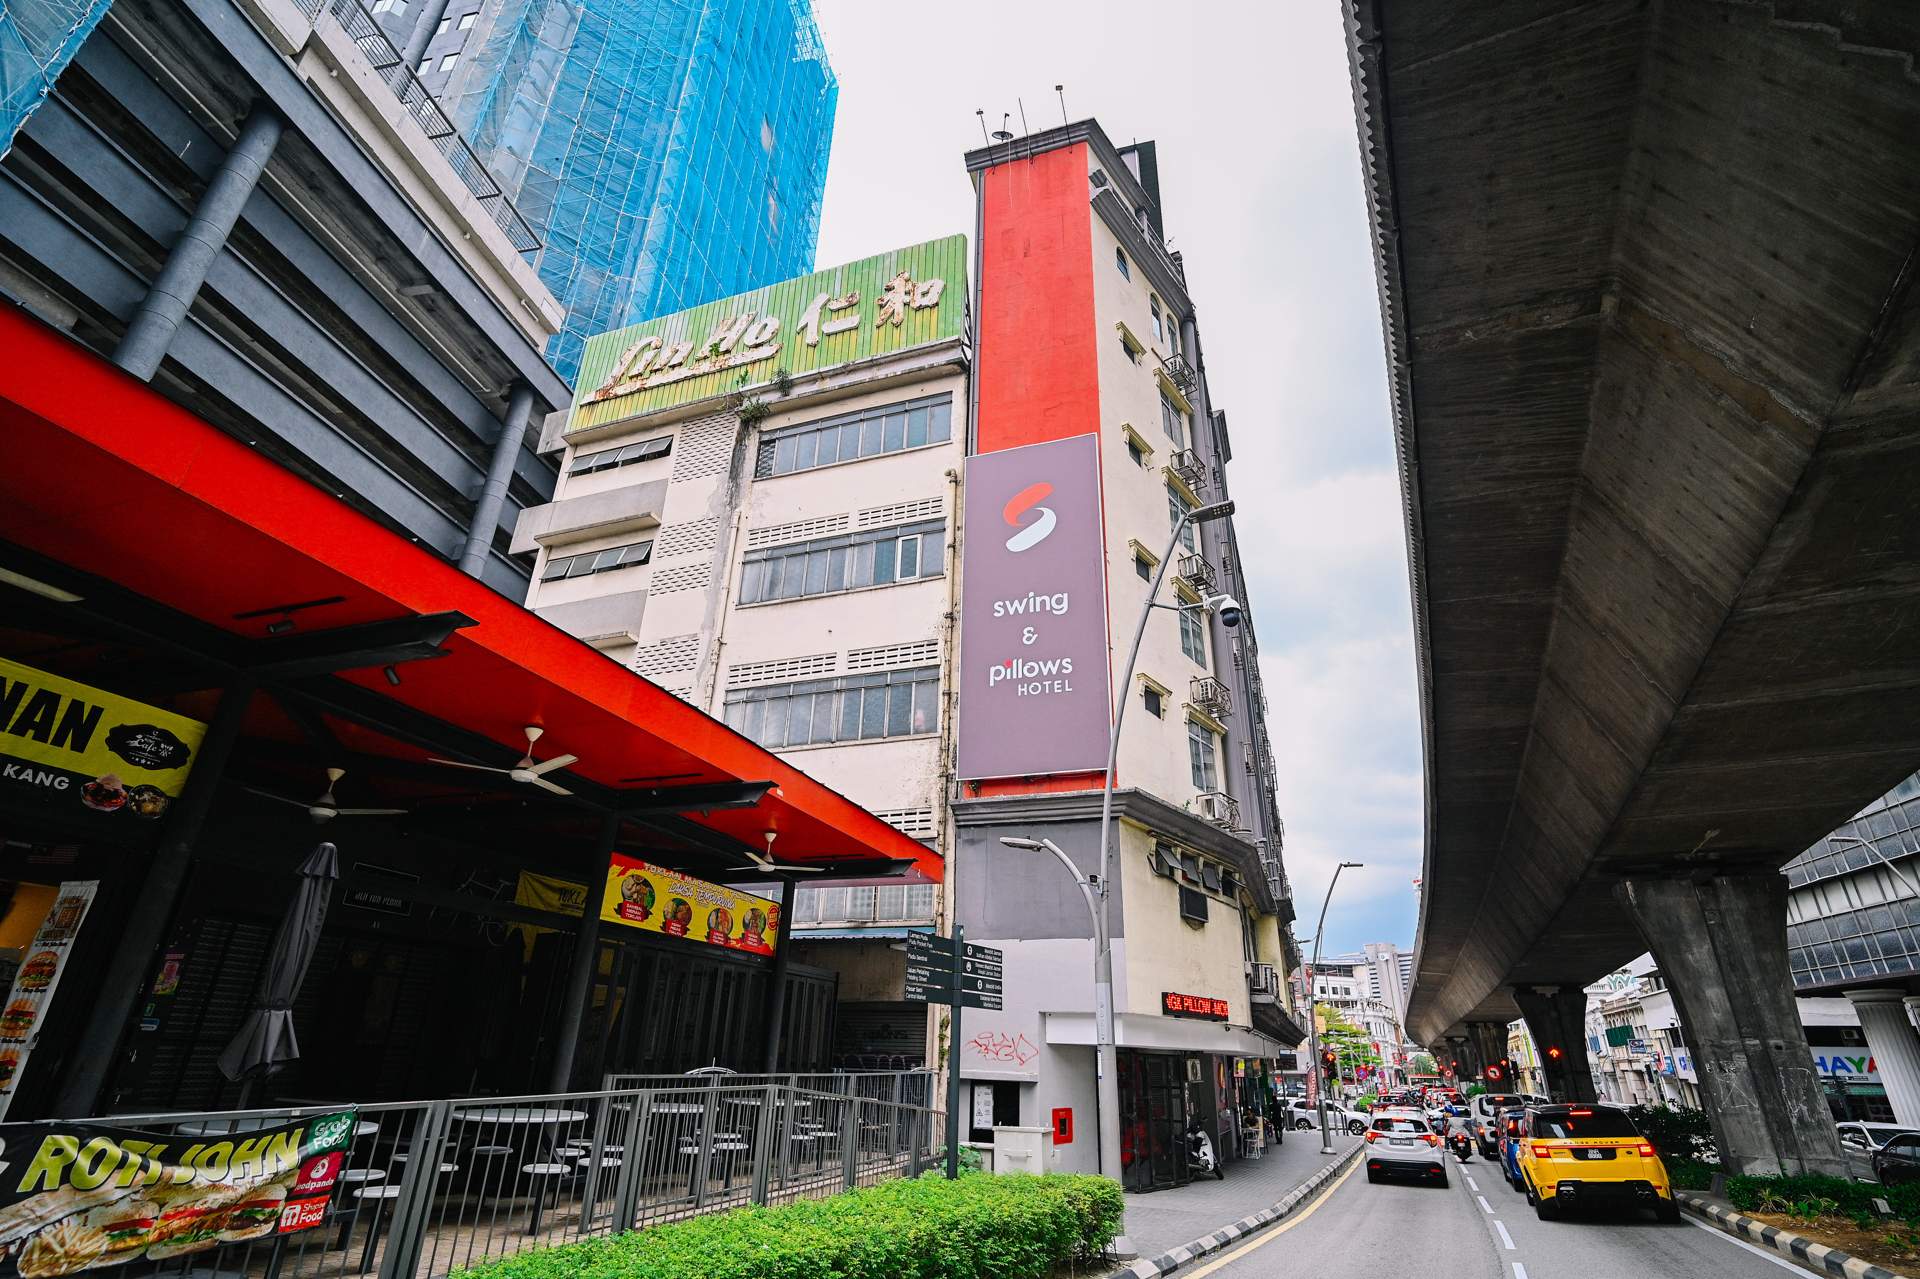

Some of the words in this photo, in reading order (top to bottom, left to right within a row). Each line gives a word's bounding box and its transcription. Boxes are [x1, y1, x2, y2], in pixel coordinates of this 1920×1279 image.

[797, 271, 946, 348] 仁和
[993, 591, 1069, 617] swing
[1022, 626, 1039, 645] &
[989, 657, 1073, 687] pillows
[1018, 679, 1073, 696] HOTEL
[3, 763, 70, 790] KANG
[314, 1115, 351, 1137] Grab
[16, 1134, 168, 1193] ROTI
[172, 1127, 304, 1184] JOHN
[300, 1209, 324, 1224] Food
